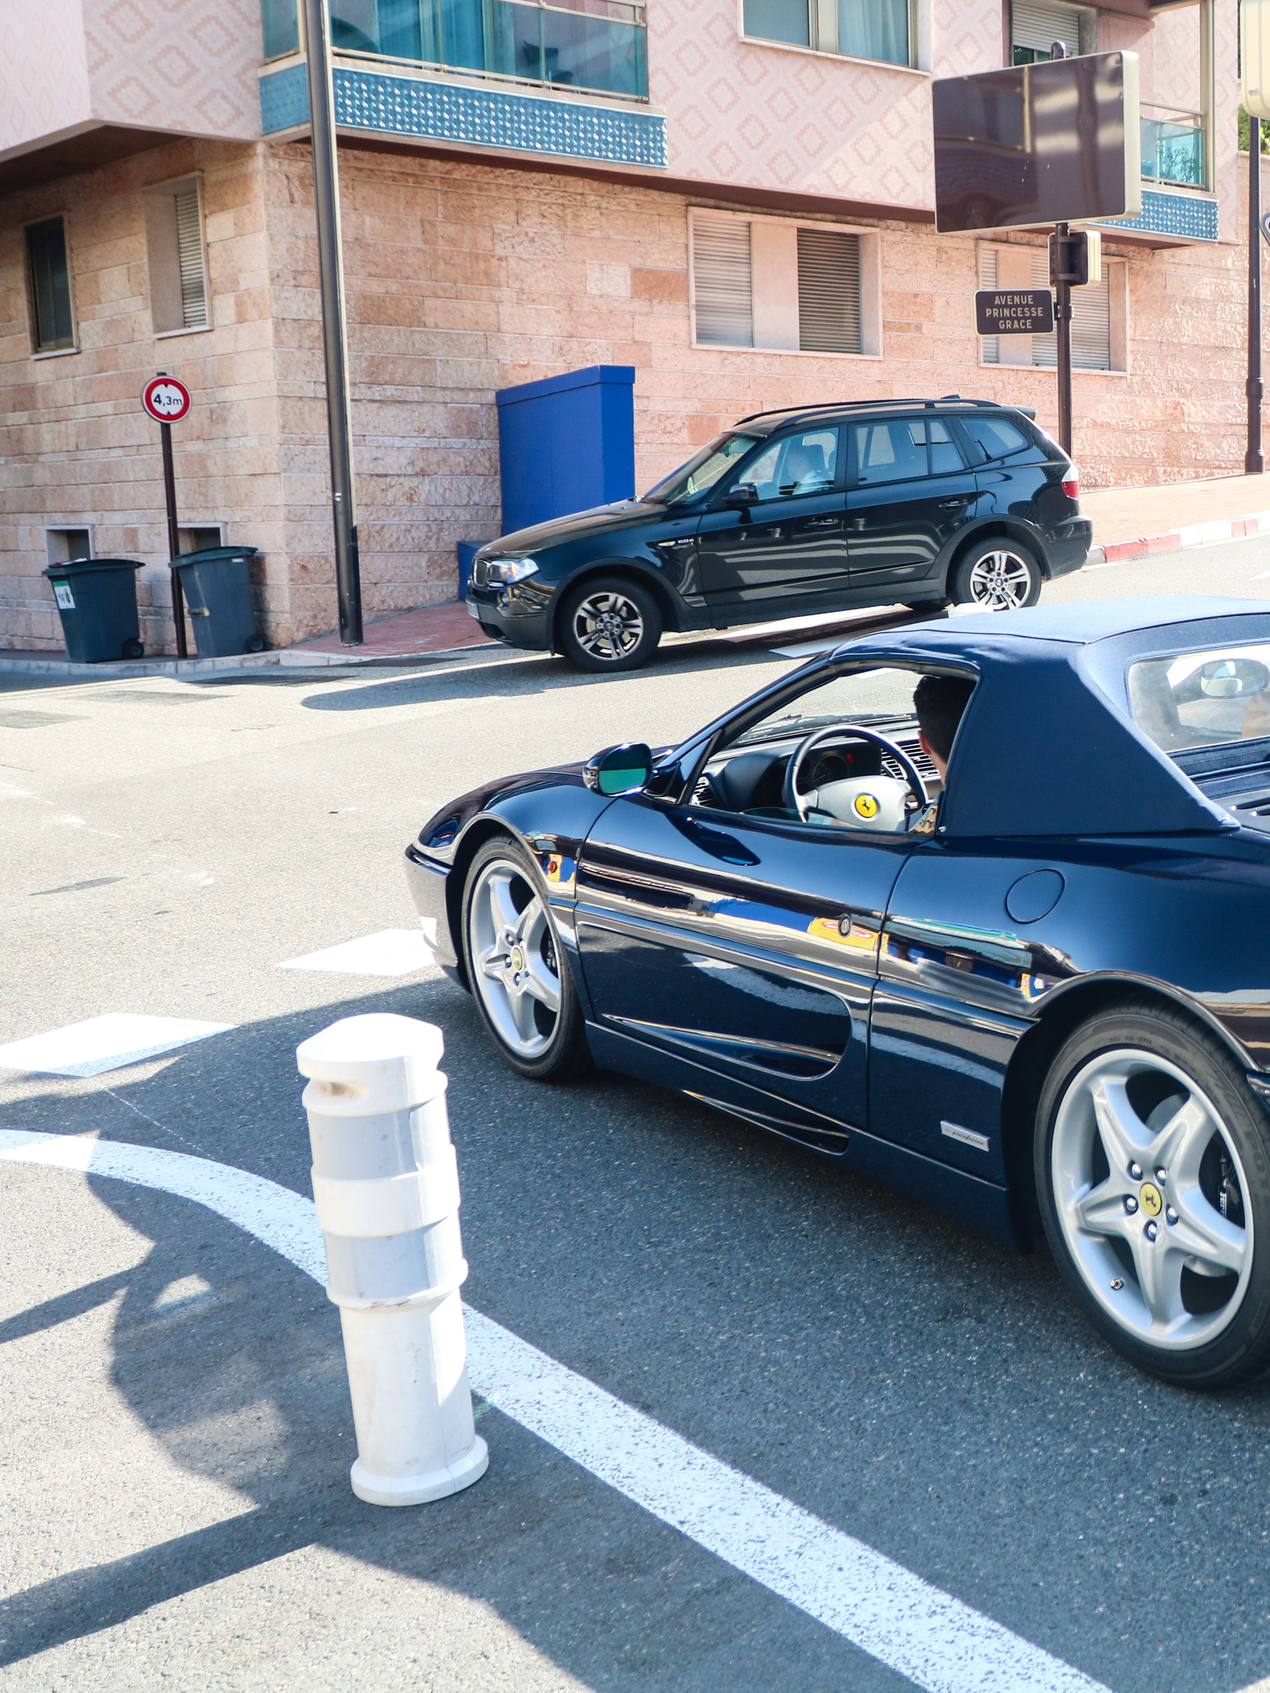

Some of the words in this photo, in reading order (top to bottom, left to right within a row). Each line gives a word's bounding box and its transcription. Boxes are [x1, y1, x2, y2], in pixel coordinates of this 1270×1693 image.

[994, 294, 1034, 305] AVENUE
[985, 307, 1044, 318] PRINCESSE
[998, 319, 1033, 330] GRACE
[153, 393, 183, 407] 4,3m
